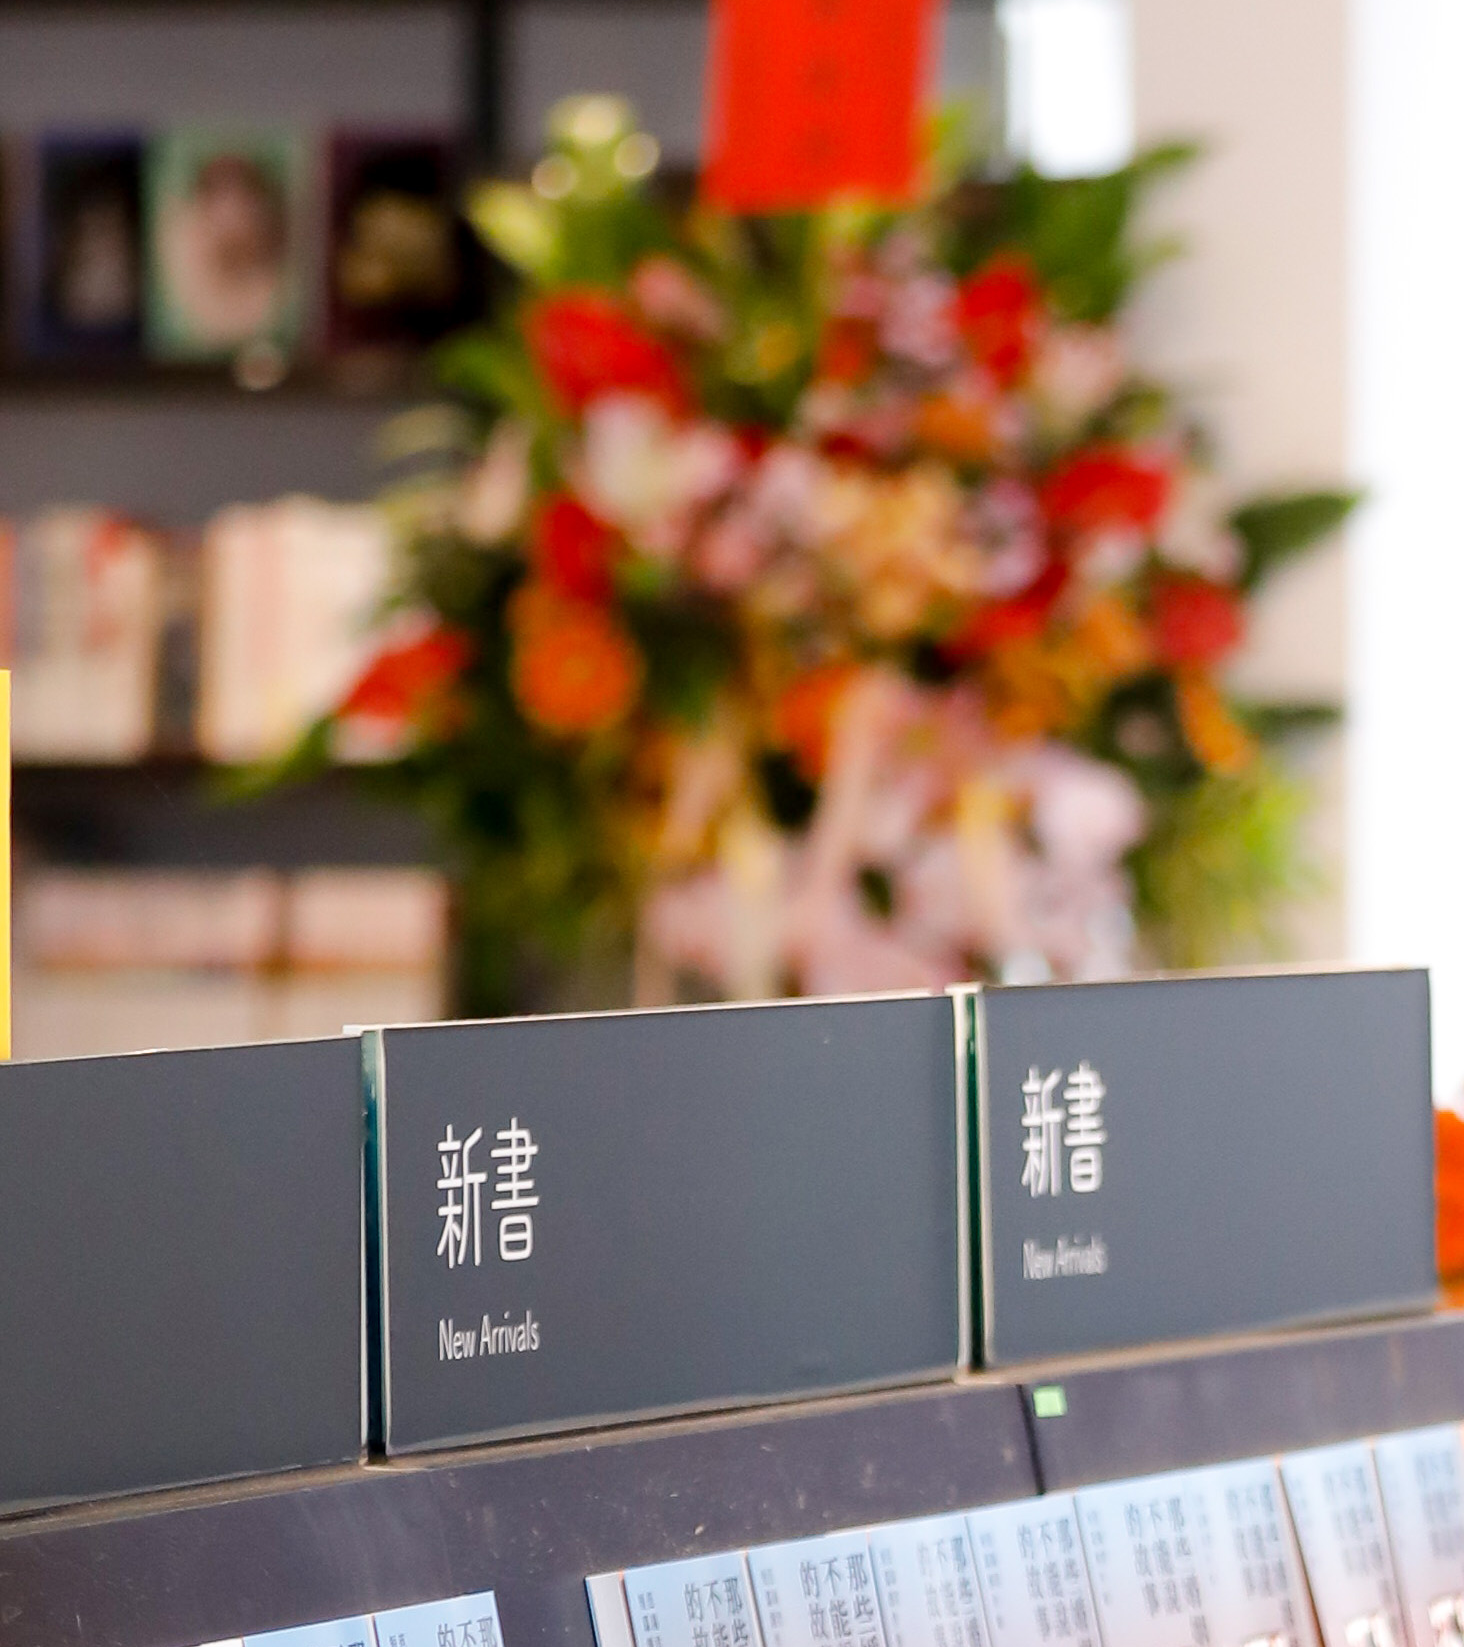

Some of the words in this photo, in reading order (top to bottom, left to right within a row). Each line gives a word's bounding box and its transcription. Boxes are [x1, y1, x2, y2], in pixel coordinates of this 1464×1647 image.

[1021, 1059, 1108, 1198] 新書
[437, 1117, 540, 1269] 新書
[1022, 1237, 1054, 1280] New
[1055, 1233, 1108, 1276] Arrivals
[438, 1318, 477, 1361] New
[479, 1310, 540, 1356] Arrivals
